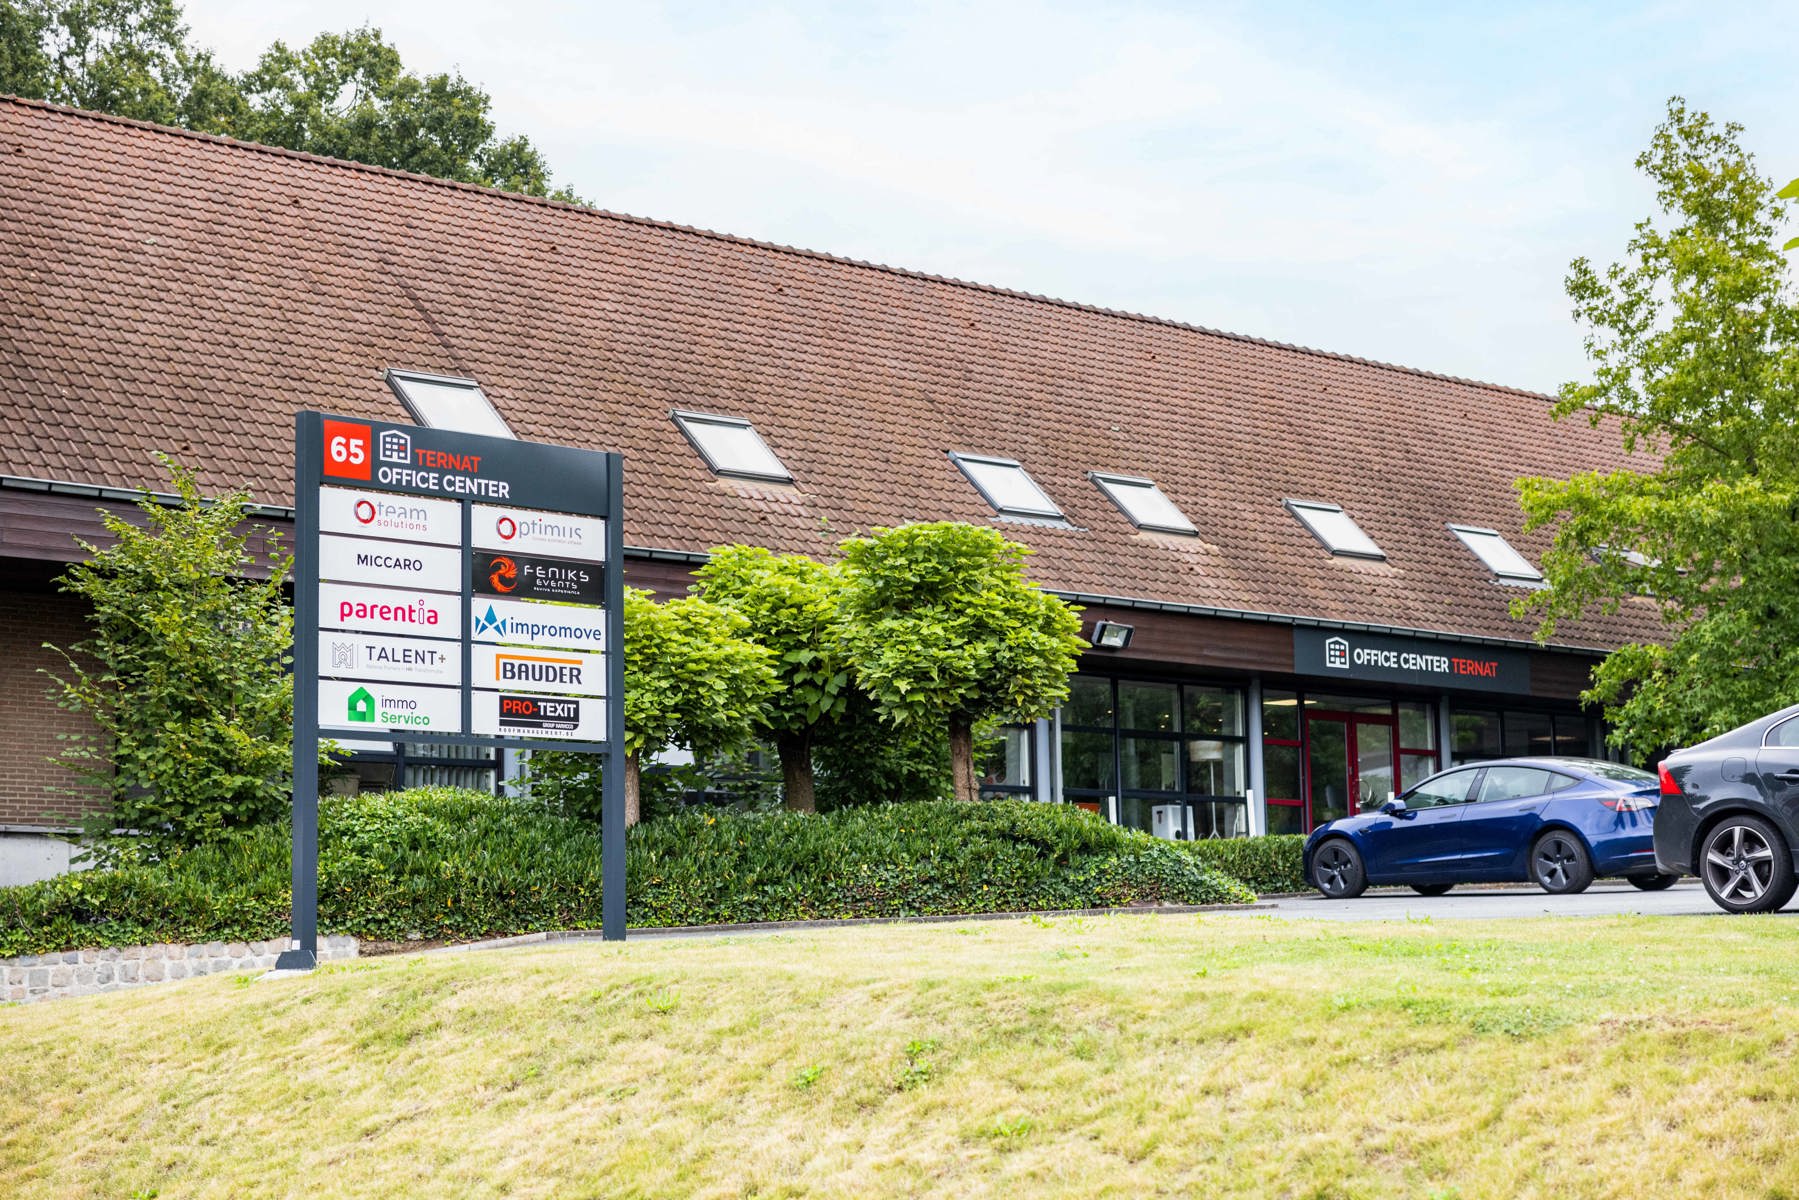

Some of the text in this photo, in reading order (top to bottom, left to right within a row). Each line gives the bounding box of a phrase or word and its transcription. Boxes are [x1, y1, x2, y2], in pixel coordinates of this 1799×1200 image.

[330, 435, 365, 465] 65
[415, 449, 481, 473] TERNAT
[378, 467, 510, 499] OFFICE CENTER
[377, 519, 428, 532] solutions
[357, 553, 423, 572] MICCARO
[524, 564, 589, 583] FENIKS
[536, 579, 578, 590] EVENTS
[340, 599, 439, 625] parentia
[510, 616, 602, 641] impromove
[502, 661, 582, 685] BAUDER
[1353, 648, 1498, 677] OFFICE CENTER TERNAT
[381, 695, 417, 710] immo
[503, 699, 577, 718] PRO-TEXIT
[381, 711, 430, 726] Servico
